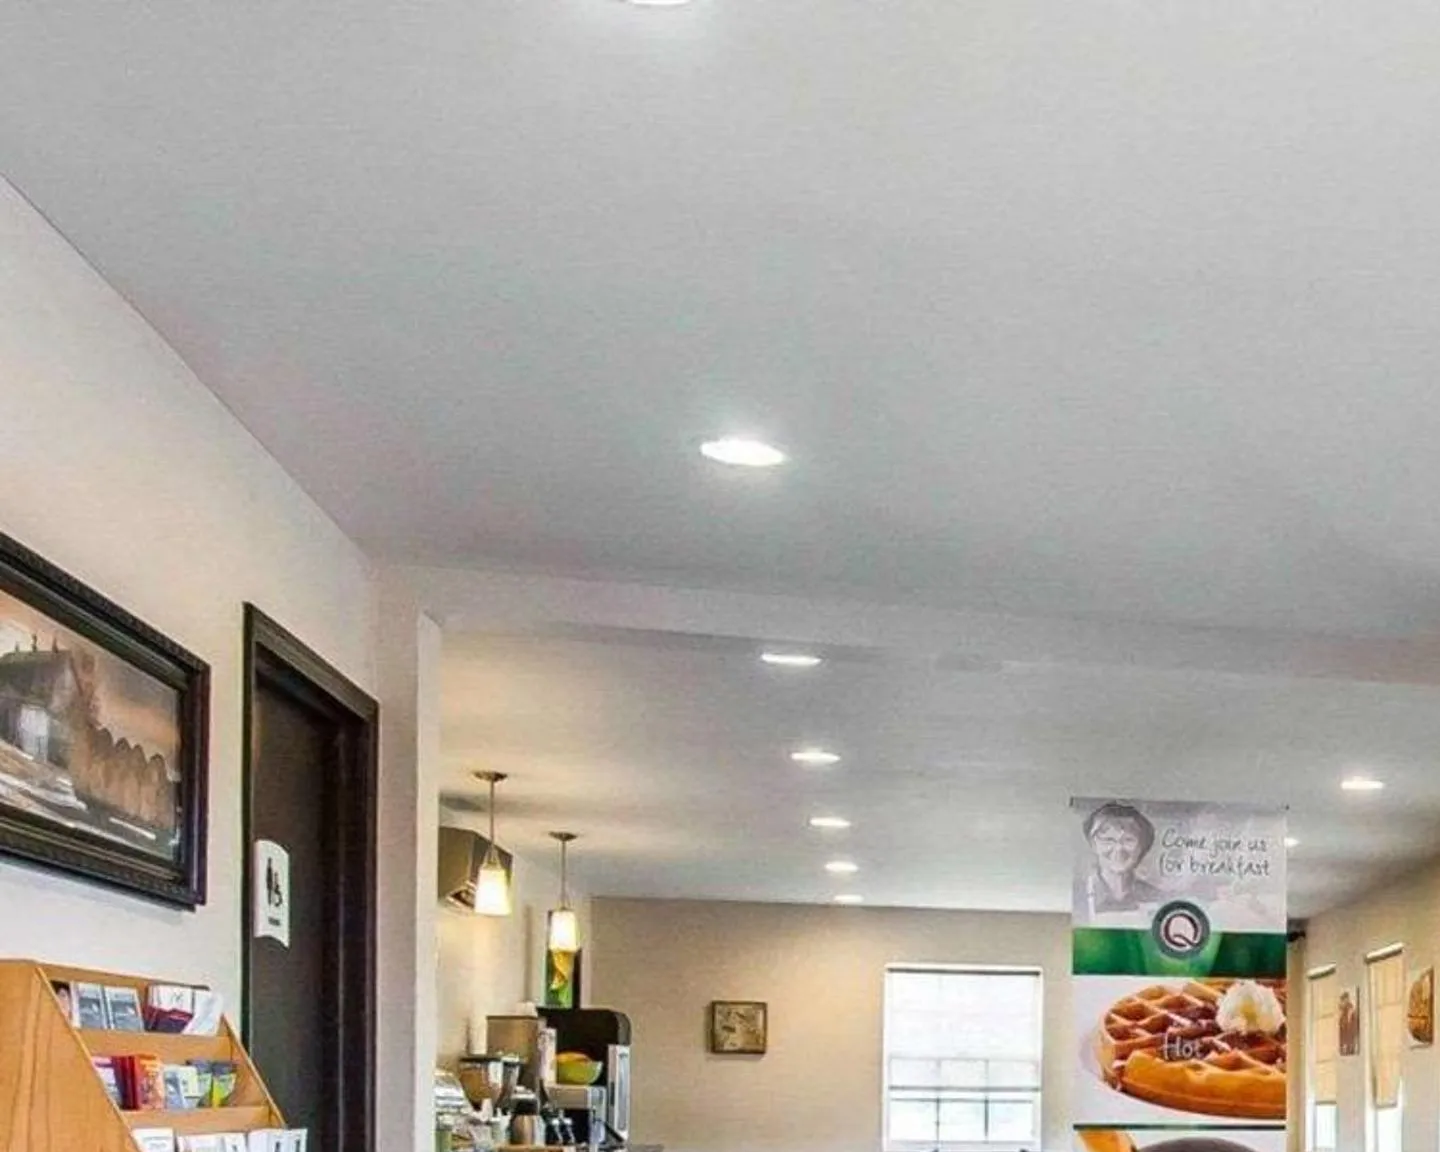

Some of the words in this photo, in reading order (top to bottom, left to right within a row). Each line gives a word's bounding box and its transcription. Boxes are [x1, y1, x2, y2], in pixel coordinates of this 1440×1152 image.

[1161, 828, 1206, 849] Come
[1208, 835, 1241, 858] join
[1247, 838, 1267, 852] us
[1159, 851, 1184, 876] for
[1190, 853, 1269, 879] breakfast
[1162, 911, 1201, 949] Q
[1160, 1030, 1203, 1060] Hot
